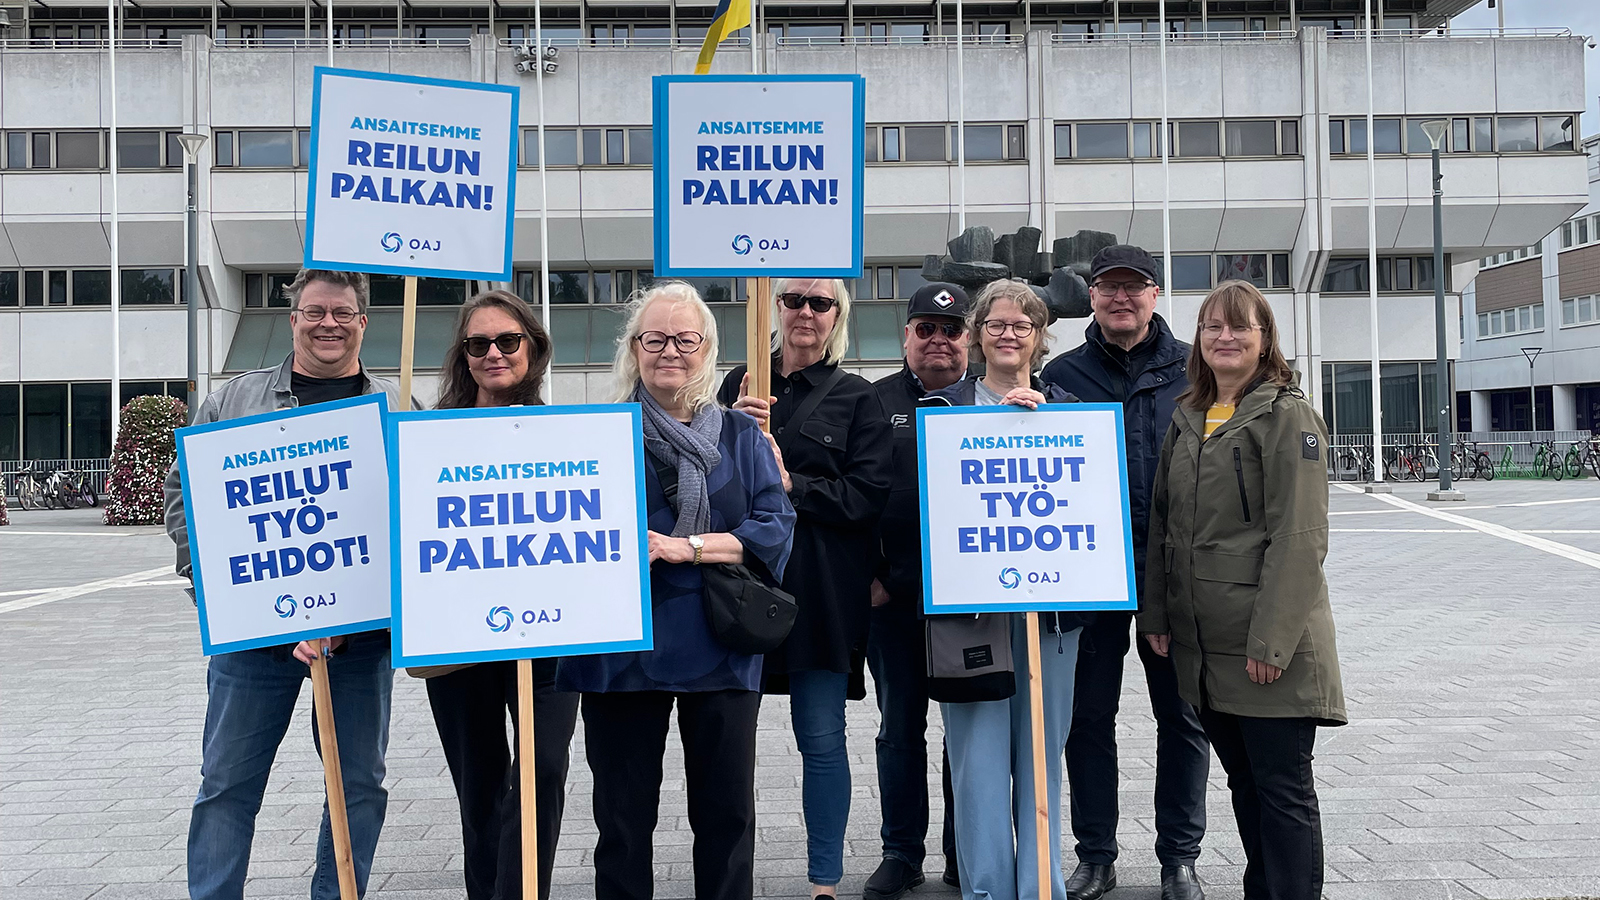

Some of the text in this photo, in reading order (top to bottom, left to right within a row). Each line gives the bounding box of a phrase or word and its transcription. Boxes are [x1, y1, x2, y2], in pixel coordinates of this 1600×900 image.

[350, 116, 482, 141] ANSAITSEMME
[697, 120, 825, 135] ANSAITSEMME
[347, 140, 481, 176] REILUN
[696, 144, 825, 172] REILUN
[330, 172, 494, 211] PALKAN!
[682, 178, 839, 206] PALKAN!
[408, 238, 442, 252] OAJ
[758, 238, 790, 251] OAJ
[222, 434, 350, 471] ANSAITSEMME
[959, 434, 1085, 450] ANSAITSEMME
[437, 459, 600, 484] ANSAITSEMME
[960, 456, 1086, 485] REILUT
[225, 460, 353, 510] REILUT
[436, 488, 602, 529] REILUN
[980, 483, 1069, 519] TYÖ-
[248, 497, 339, 544] TYÖ-
[419, 529, 622, 574] PALKAN!
[957, 524, 1096, 554] EHDOT!
[228, 534, 371, 586] EHDOT!
[1027, 571, 1062, 585] OAJ
[303, 592, 337, 610] OAJ
[521, 608, 562, 625] OAJ
